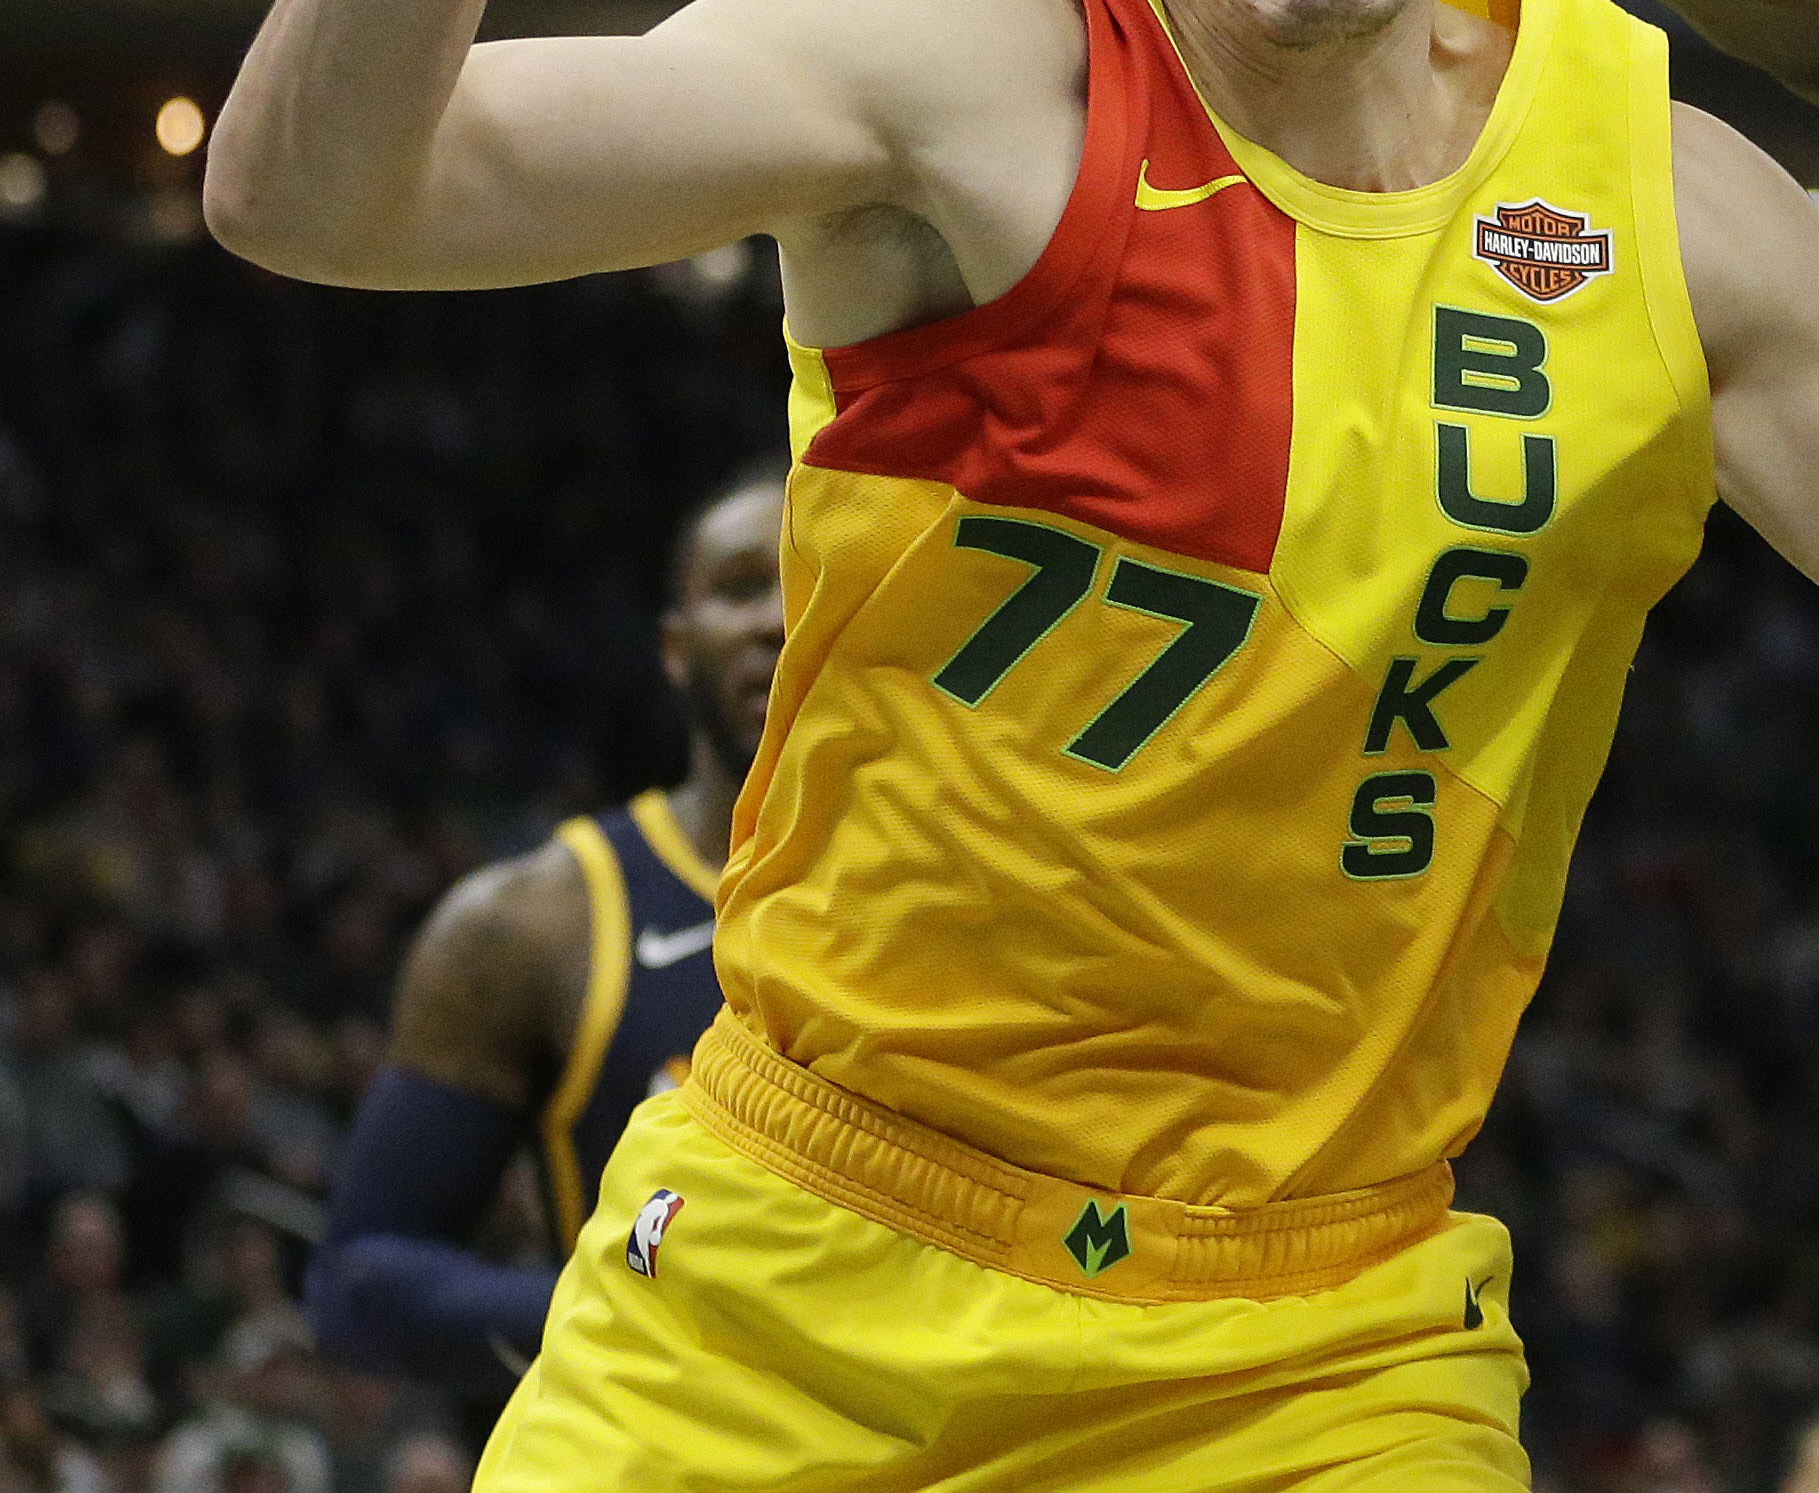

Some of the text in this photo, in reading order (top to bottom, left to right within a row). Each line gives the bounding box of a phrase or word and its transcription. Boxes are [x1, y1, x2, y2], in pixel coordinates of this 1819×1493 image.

[1508, 212, 1571, 236] MOTOR
[1484, 230, 1600, 265] HARLEY-DAVIDSON
[1510, 264, 1572, 293] CYCLES
[1340, 304, 1557, 879] BUCKS
[929, 515, 1263, 774] 77
